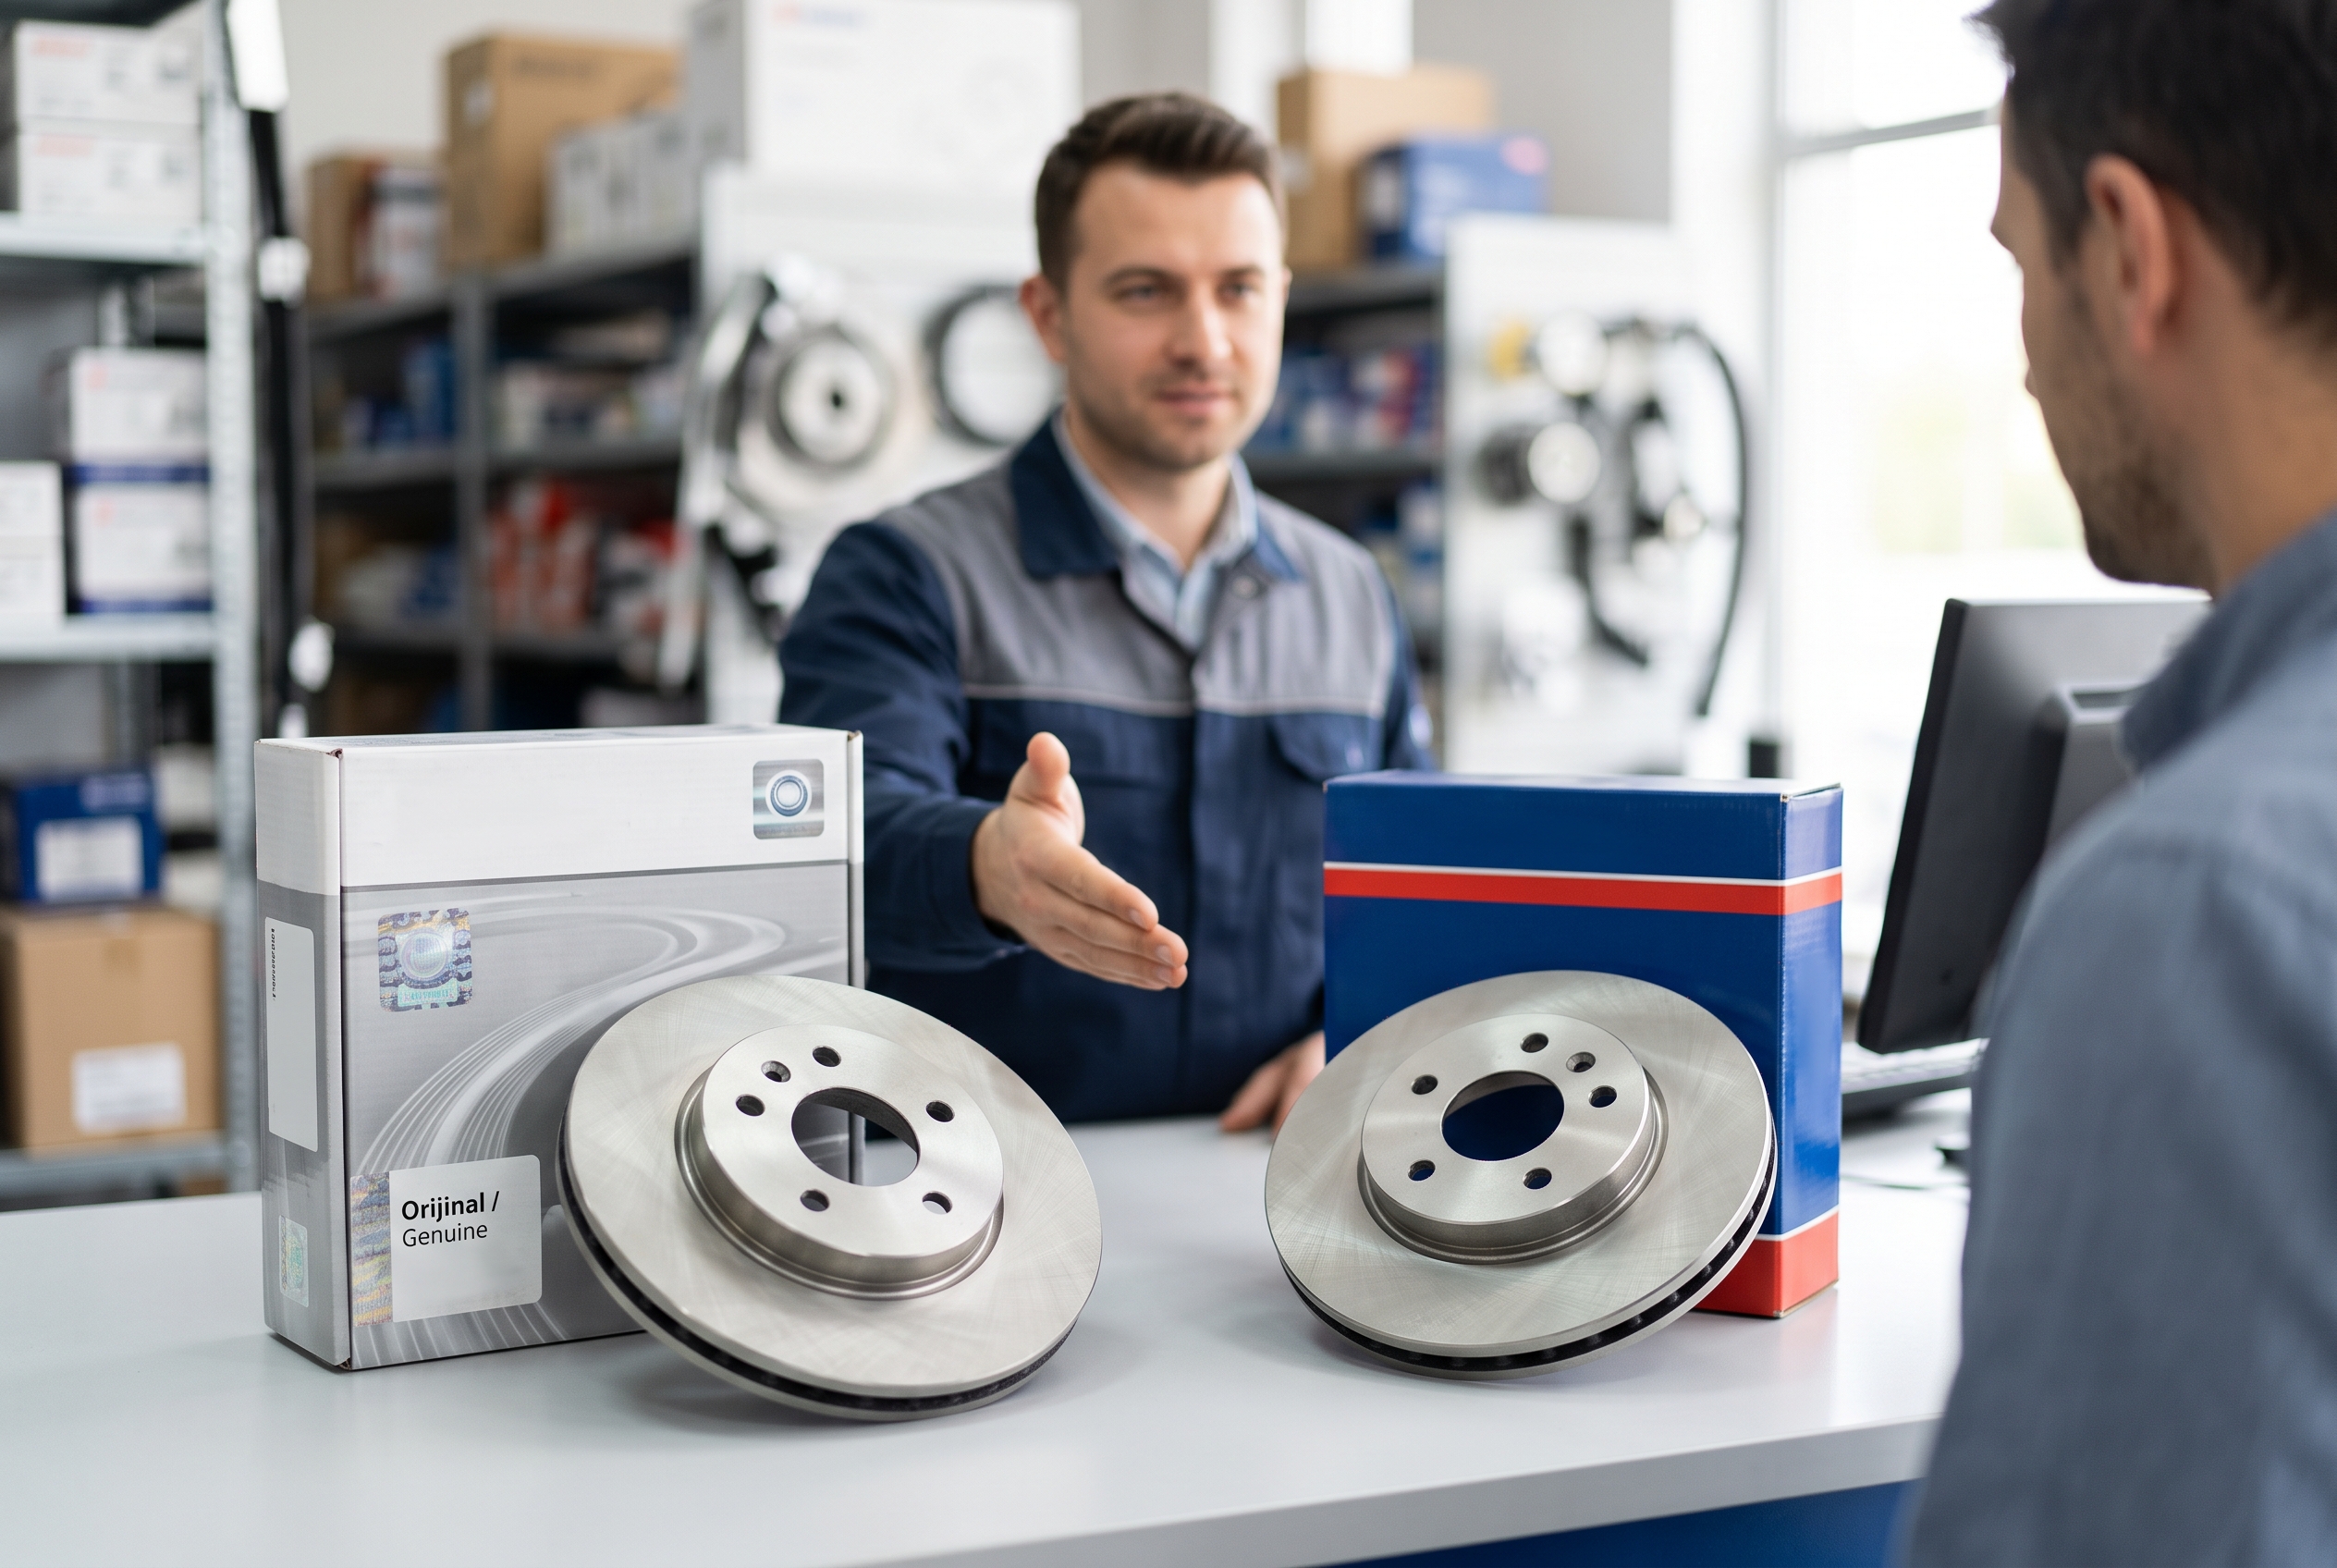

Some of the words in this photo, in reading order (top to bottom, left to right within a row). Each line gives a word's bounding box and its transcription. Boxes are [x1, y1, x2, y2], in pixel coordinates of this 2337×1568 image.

[401, 1192, 484, 1222] Orijinal
[491, 1191, 500, 1212] /
[402, 1223, 488, 1247] Genuine
